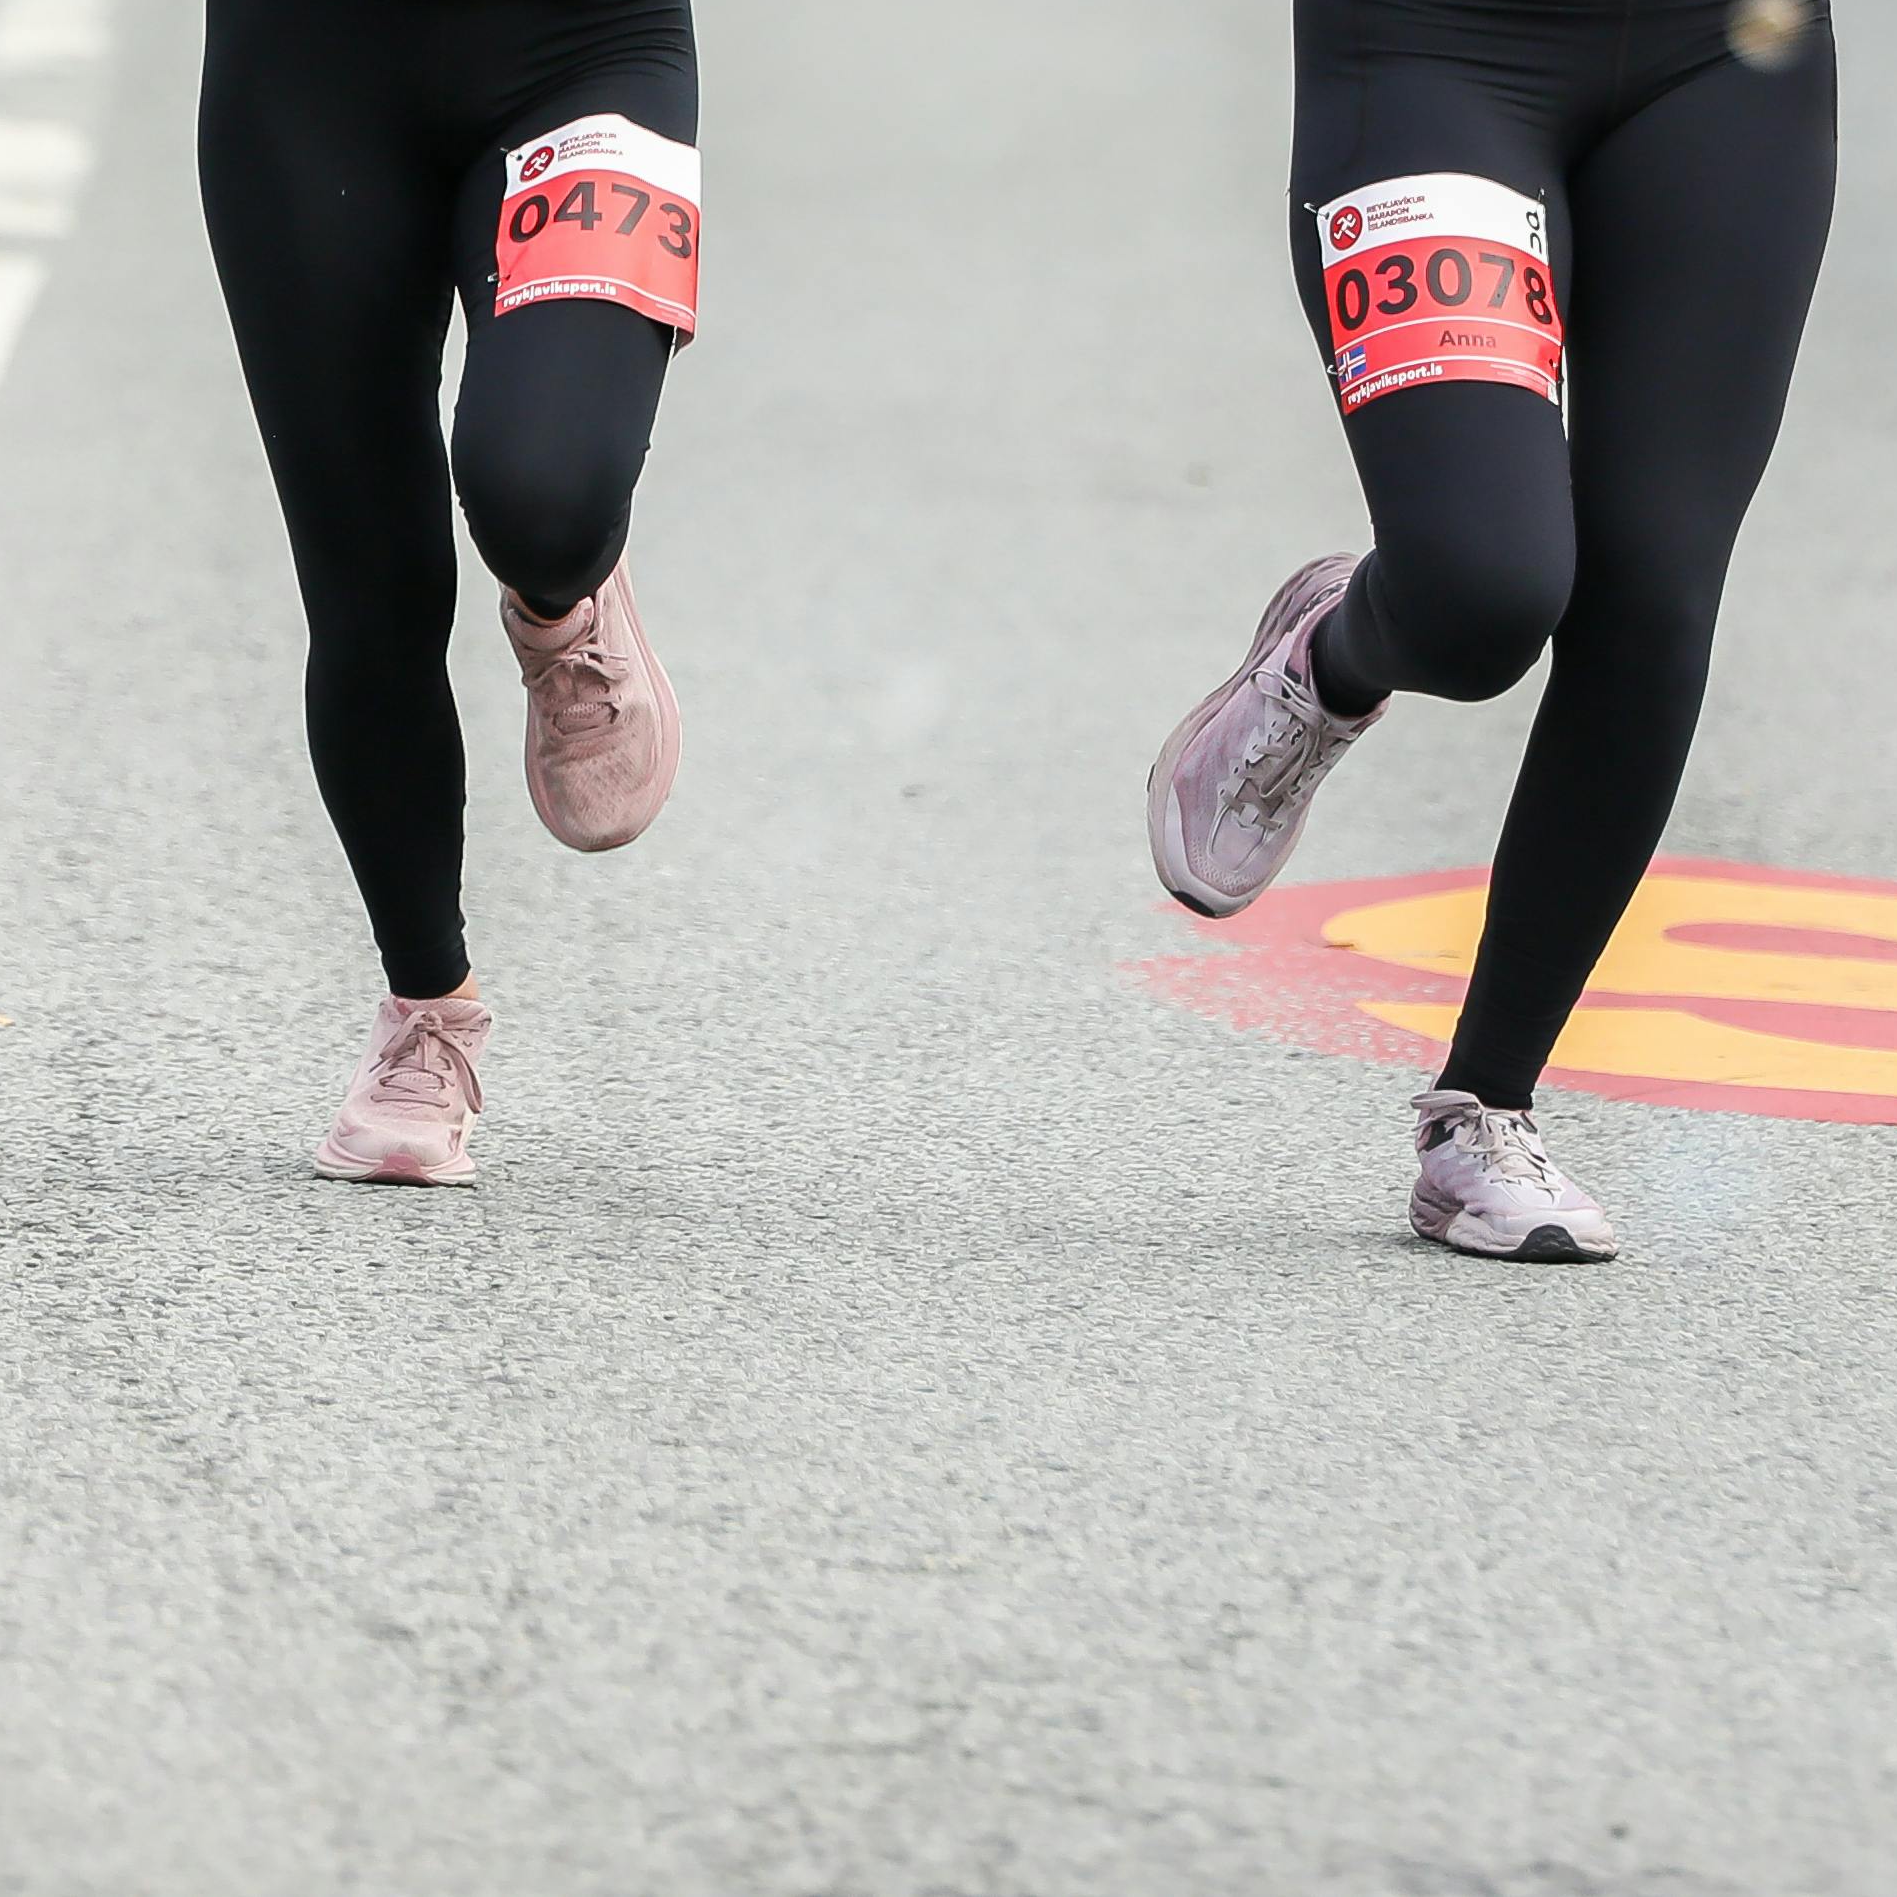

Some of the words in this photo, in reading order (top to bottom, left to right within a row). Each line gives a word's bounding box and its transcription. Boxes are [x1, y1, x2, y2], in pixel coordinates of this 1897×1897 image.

[509, 181, 692, 259] 0473
[503, 282, 616, 308] reykjaviksport.is
[1336, 248, 1552, 331] 03078
[1439, 330, 1497, 349] Anna
[1348, 363, 1443, 405] reykjaviksport.is
